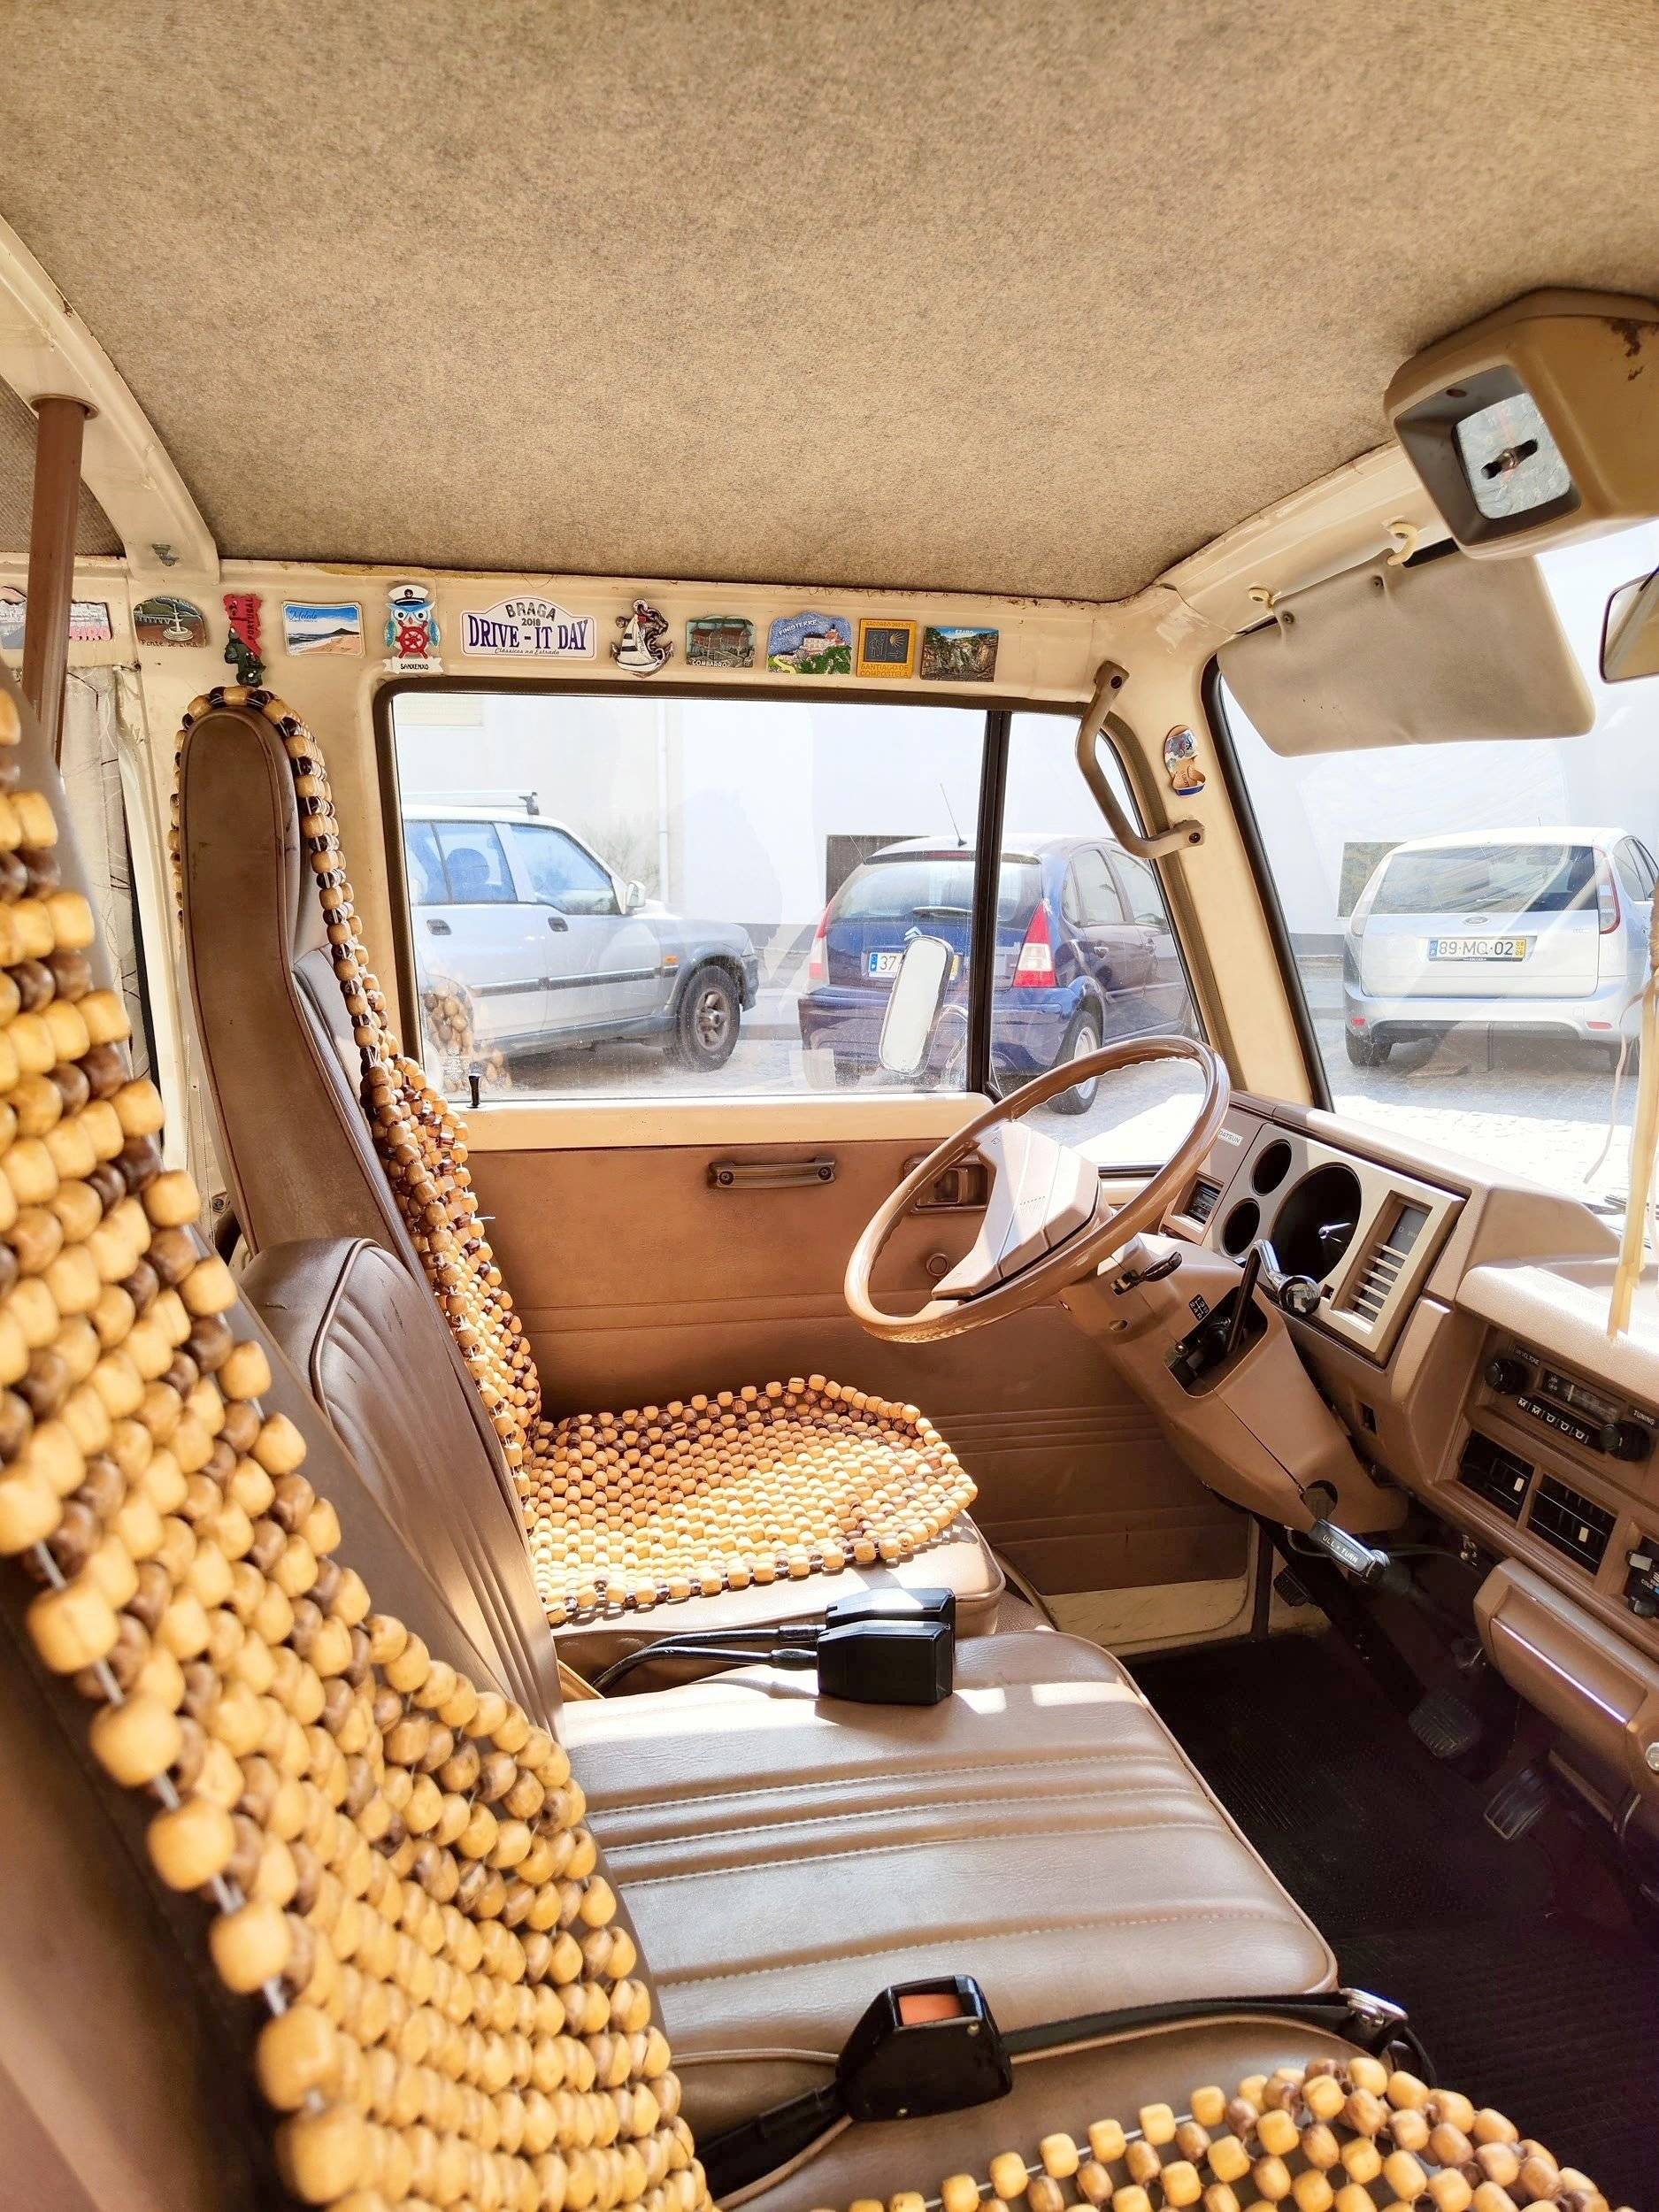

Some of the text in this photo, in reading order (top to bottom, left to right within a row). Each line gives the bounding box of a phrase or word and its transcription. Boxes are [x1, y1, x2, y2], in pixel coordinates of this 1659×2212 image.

[246, 597, 255, 640] PORTUGAL
[505, 602, 557, 622] BRAGA
[521, 618, 541, 626] 2018
[779, 619, 818, 636] FINISTERRE
[467, 614, 520, 649] DRIVE
[534, 626, 553, 649] IT
[557, 618, 589, 650] DAY
[1217, 1130, 1241, 1143] DATSUN
[1340, 1548, 1359, 1564] TURN
